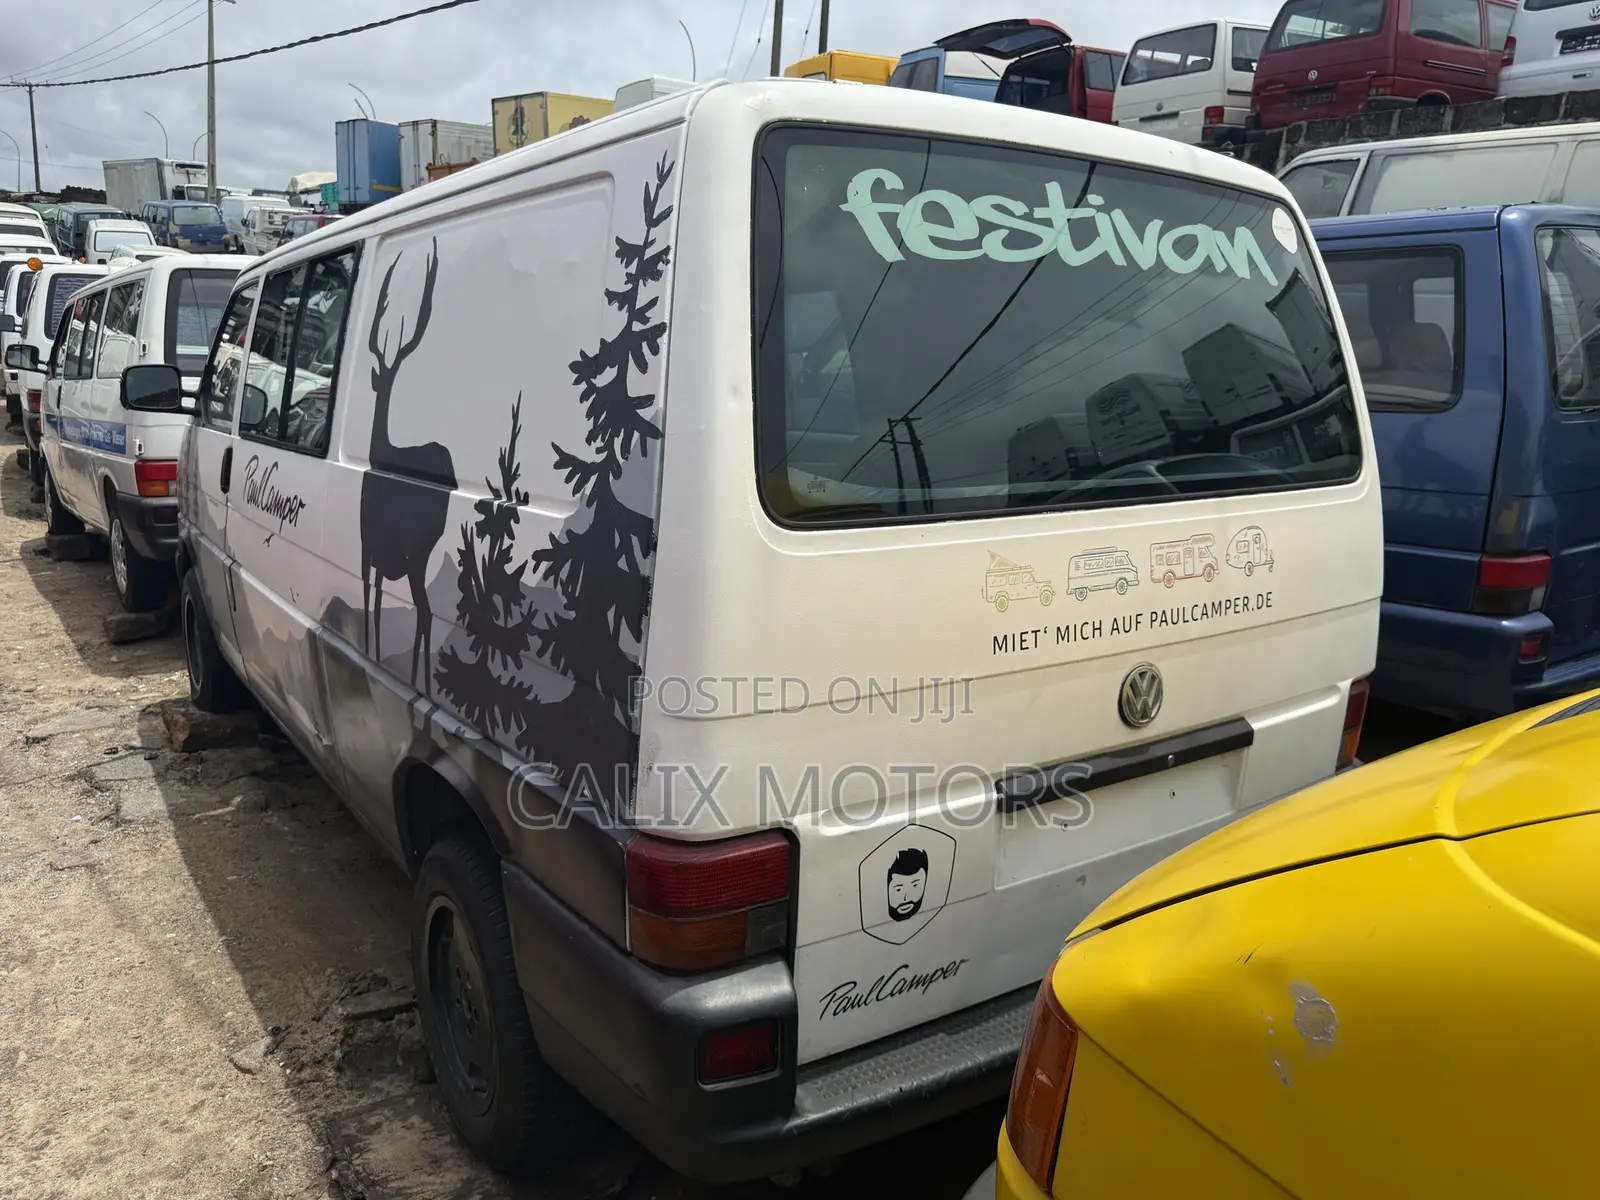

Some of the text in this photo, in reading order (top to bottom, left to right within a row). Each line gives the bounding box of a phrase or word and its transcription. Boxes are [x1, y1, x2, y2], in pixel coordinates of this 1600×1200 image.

[840, 168, 1279, 287] festivan
[242, 454, 306, 534] PaulCamper
[1056, 619, 1102, 645] MICH
[1110, 613, 1143, 636] AUF
[1149, 591, 1273, 629] PAULCAMPER.DE
[819, 957, 972, 1021] PaulCamper
